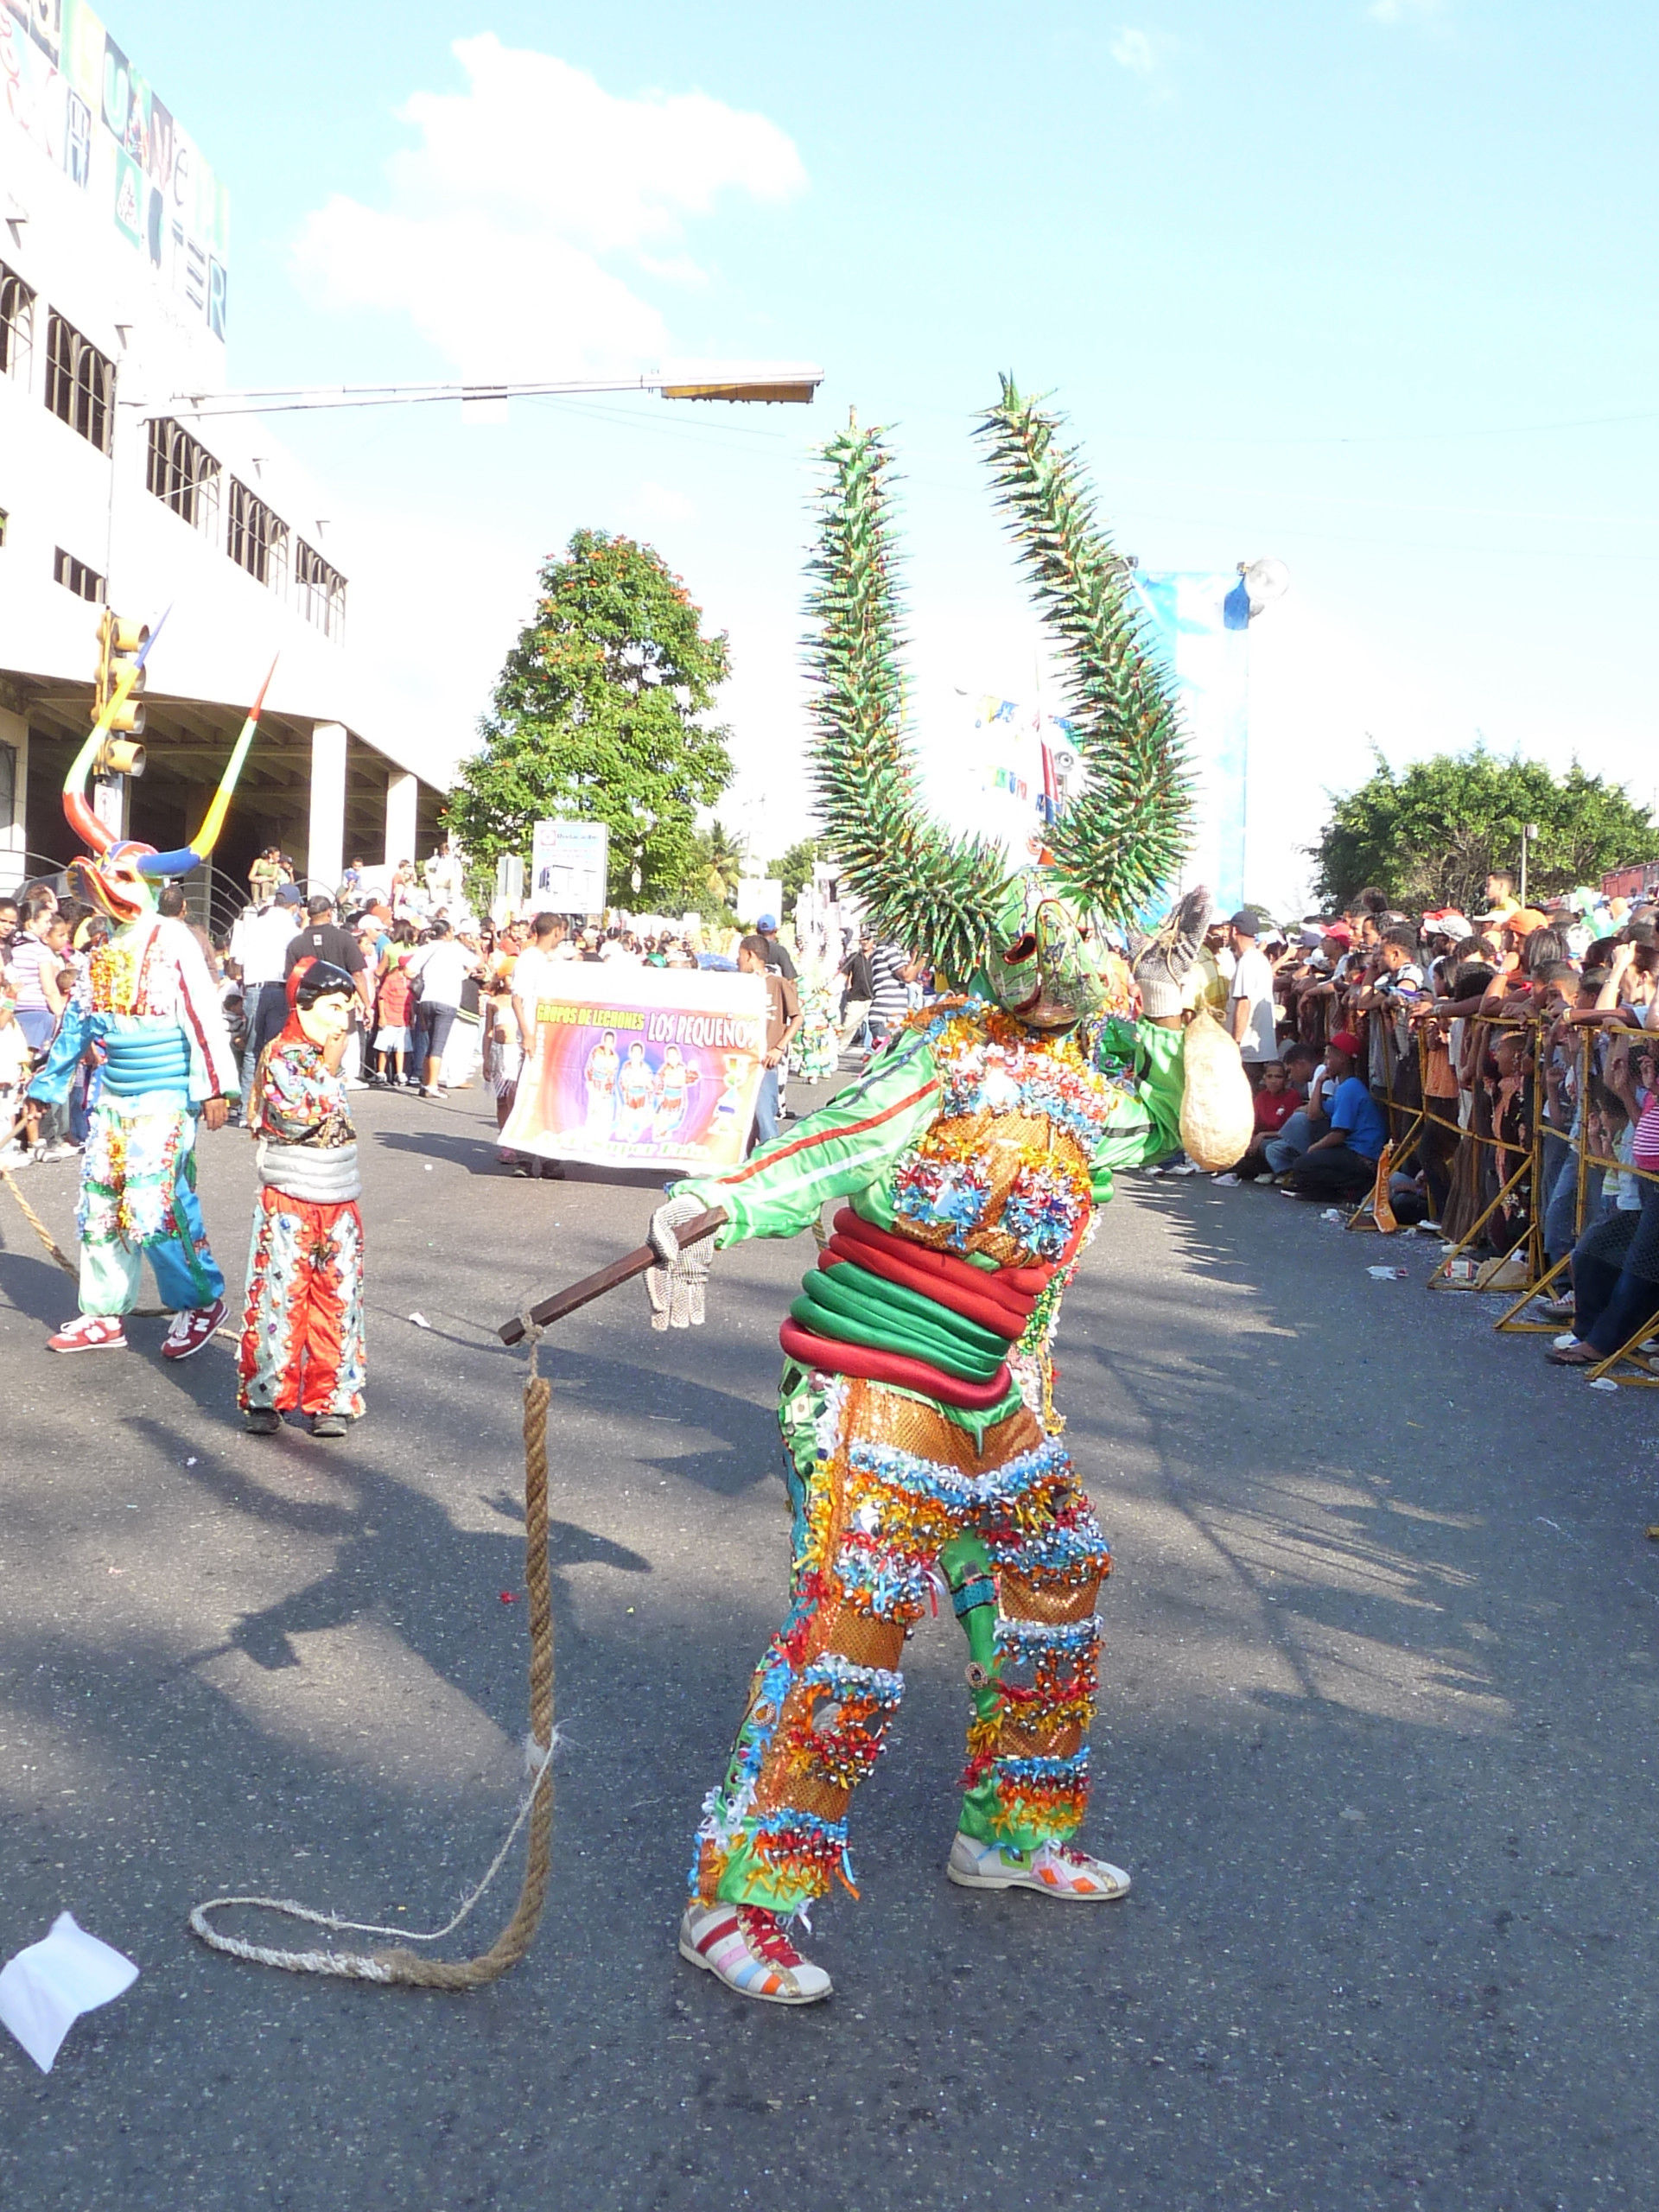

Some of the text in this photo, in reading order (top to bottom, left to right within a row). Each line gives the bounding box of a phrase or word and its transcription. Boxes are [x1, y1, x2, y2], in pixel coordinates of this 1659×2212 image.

[537, 1003, 645, 1032] GRUPOS DE LECHONES
[647, 1012, 676, 1044] LOS
[194, 1317, 211, 1332] N
